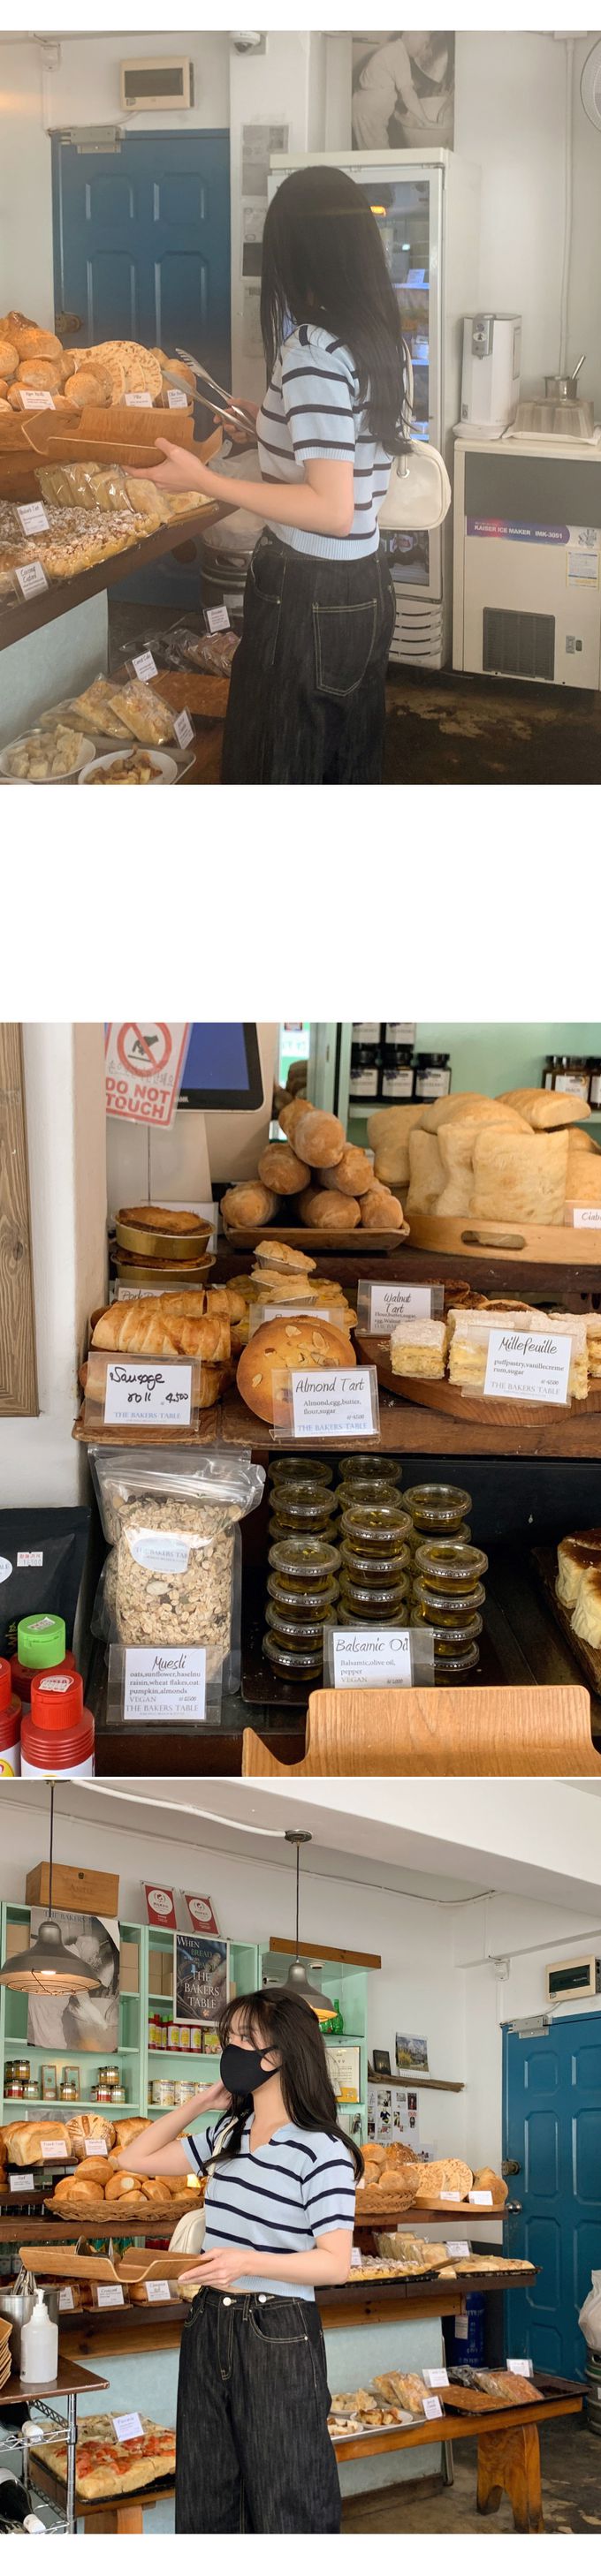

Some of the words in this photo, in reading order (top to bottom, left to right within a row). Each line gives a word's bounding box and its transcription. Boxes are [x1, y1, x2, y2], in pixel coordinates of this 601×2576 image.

[106, 1076, 128, 1094] DO
[134, 1084, 170, 1104] NOT
[106, 1092, 164, 1119] TOUCH
[384, 1291, 412, 1303] Walnut
[385, 1303, 405, 1313] Tart
[498, 1335, 558, 1356] Millefeuille
[493, 1367, 524, 1376] rum,sugar
[295, 1377, 336, 1393] Almond
[340, 1378, 365, 1392] Tart
[507, 1383, 536, 1393] BAKERS
[538, 1386, 560, 1395] TABLE
[336, 1635, 385, 1652] Balsamic
[390, 1637, 408, 1651] Oil
[152, 1653, 186, 1671] Muesli
[177, 1935, 200, 1948] WHEN
[193, 1971, 210, 1982] THE
[184, 1983, 220, 1996] BAKERS
[187, 1996, 217, 2009] TABLE
